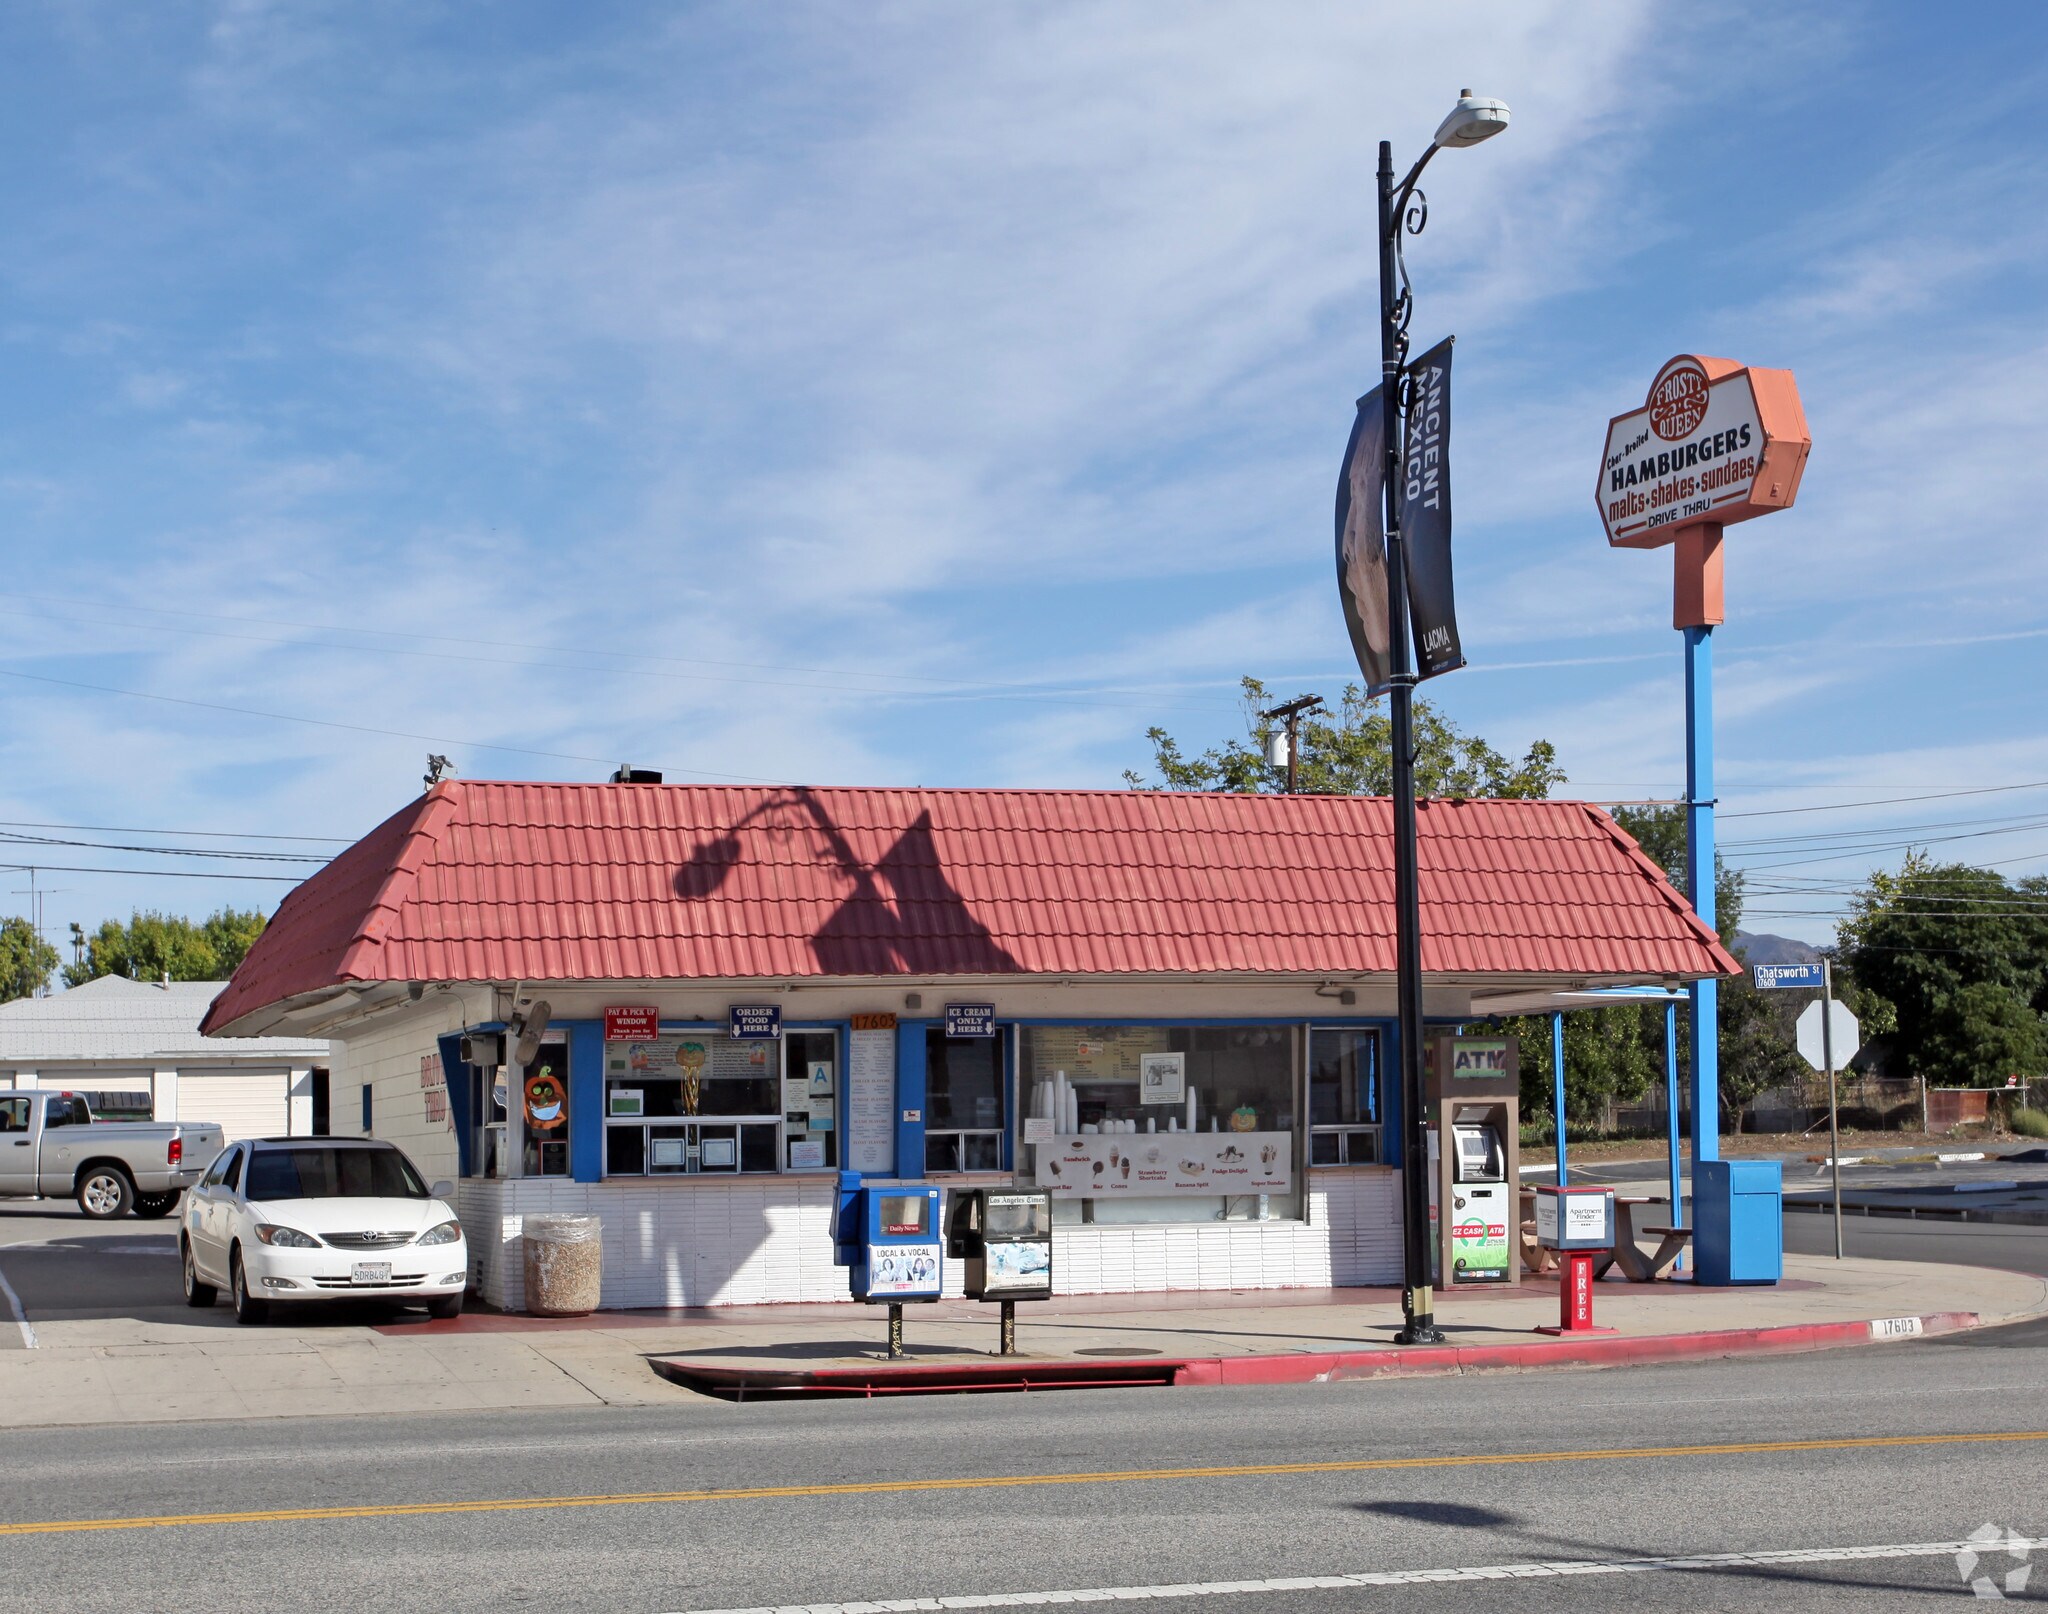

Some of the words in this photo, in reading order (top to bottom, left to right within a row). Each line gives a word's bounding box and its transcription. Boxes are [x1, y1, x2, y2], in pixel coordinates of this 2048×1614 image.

[1656, 372, 1702, 405] FROSTY
[1659, 407, 1701, 438] QUEEN
[1406, 371, 1428, 501] MEXICO
[1423, 366, 1442, 510] ANCIENT
[1607, 429, 1649, 470] Char-Broiled
[1611, 423, 1751, 492] HAMBURGERS
[1609, 491, 1645, 522] malts
[1651, 475, 1695, 509] shakes
[1701, 455, 1755, 492] sundaes
[1649, 508, 1677, 528] DRIVE
[1683, 498, 1711, 517] THRU
[1423, 625, 1451, 652] LACMA
[1757, 967, 1809, 979] Chatsworth
[1812, 965, 1820, 974] St
[1757, 978, 1776, 987] 17600
[736, 1008, 774, 1016] ORDER
[949, 1008, 961, 1016] ICE
[964, 1008, 991, 1016] CREAM
[854, 1014, 897, 1029] 17603
[957, 1017, 983, 1025] ONLY
[957, 1025, 983, 1033] HERE
[1455, 1050, 1505, 1069] ATM
[815, 1067, 828, 1083] A
[989, 1196, 1000, 1204] Los
[1002, 1196, 1025, 1205] Angeles
[1027, 1196, 1045, 1204] Times
[1570, 1208, 1603, 1216] Apartment
[1463, 1227, 1483, 1235] CASH
[1489, 1227, 1504, 1235] ATM
[876, 1249, 898, 1257] LOCAL
[908, 1248, 930, 1256] VOCAL
[1577, 1262, 1587, 1320] FREE
[1883, 1319, 1914, 1335] 17603
